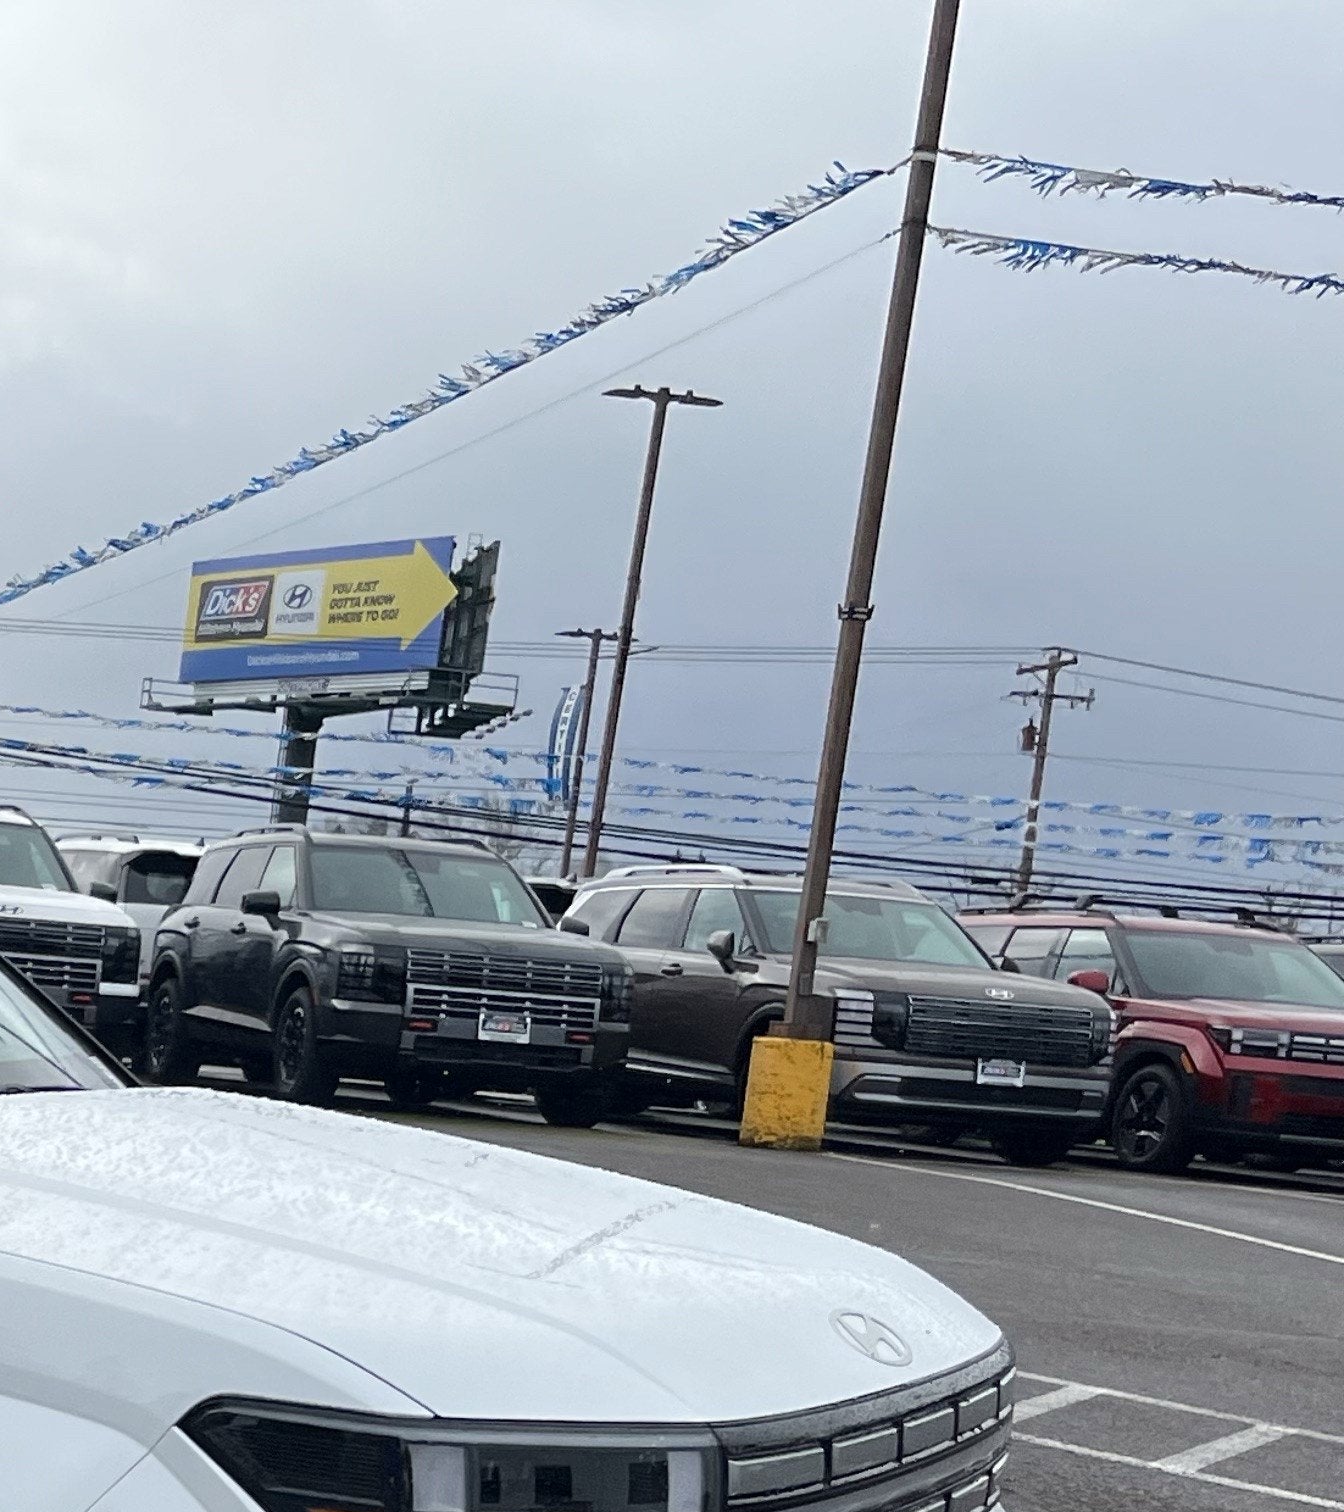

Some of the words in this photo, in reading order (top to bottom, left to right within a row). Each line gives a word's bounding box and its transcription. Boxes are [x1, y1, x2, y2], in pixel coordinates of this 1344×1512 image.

[332, 583, 353, 594] YOU
[206, 588, 260, 615] Dick's
[362, 594, 395, 607] KNOW
[366, 611, 379, 621] TO
